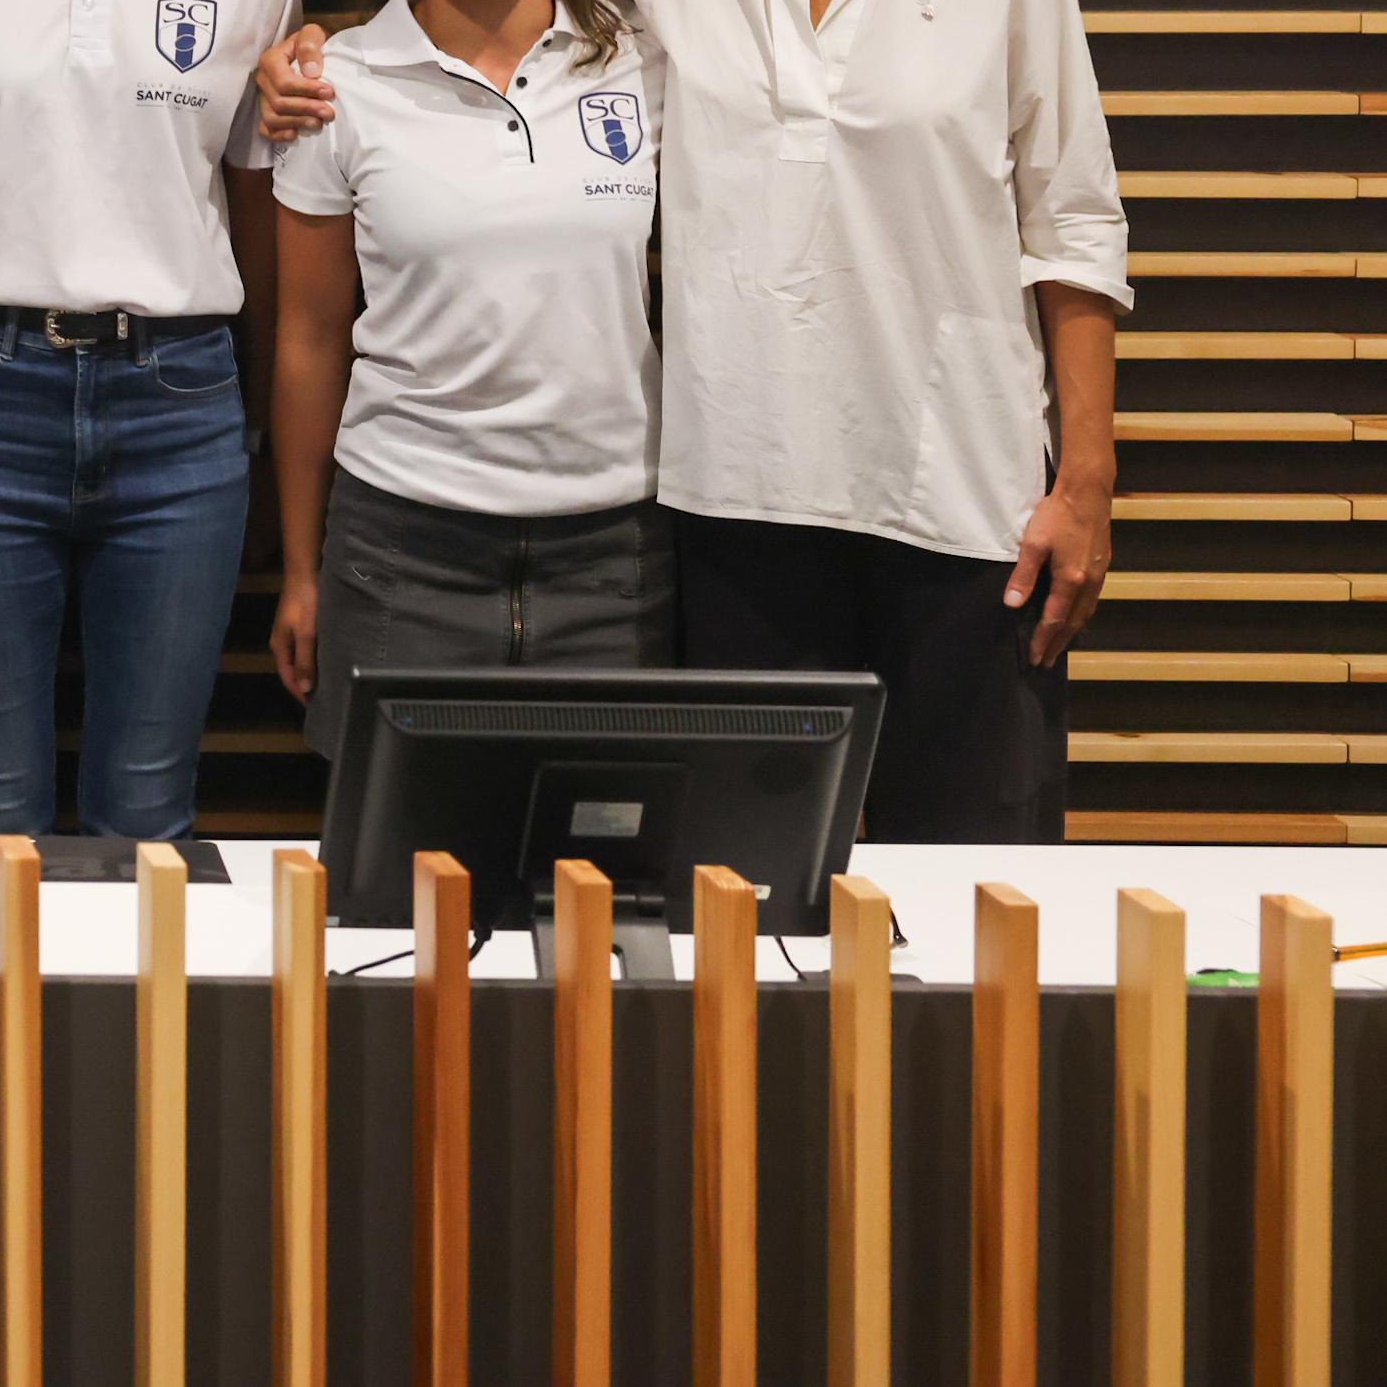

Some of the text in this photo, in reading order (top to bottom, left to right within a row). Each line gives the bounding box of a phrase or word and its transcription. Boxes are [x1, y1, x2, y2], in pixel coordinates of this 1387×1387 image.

[163, 2, 210, 26] SC
[136, 90, 172, 102] SANT
[174, 94, 209, 109] CUGAT
[586, 98, 635, 122] SC
[585, 184, 622, 196] SANT
